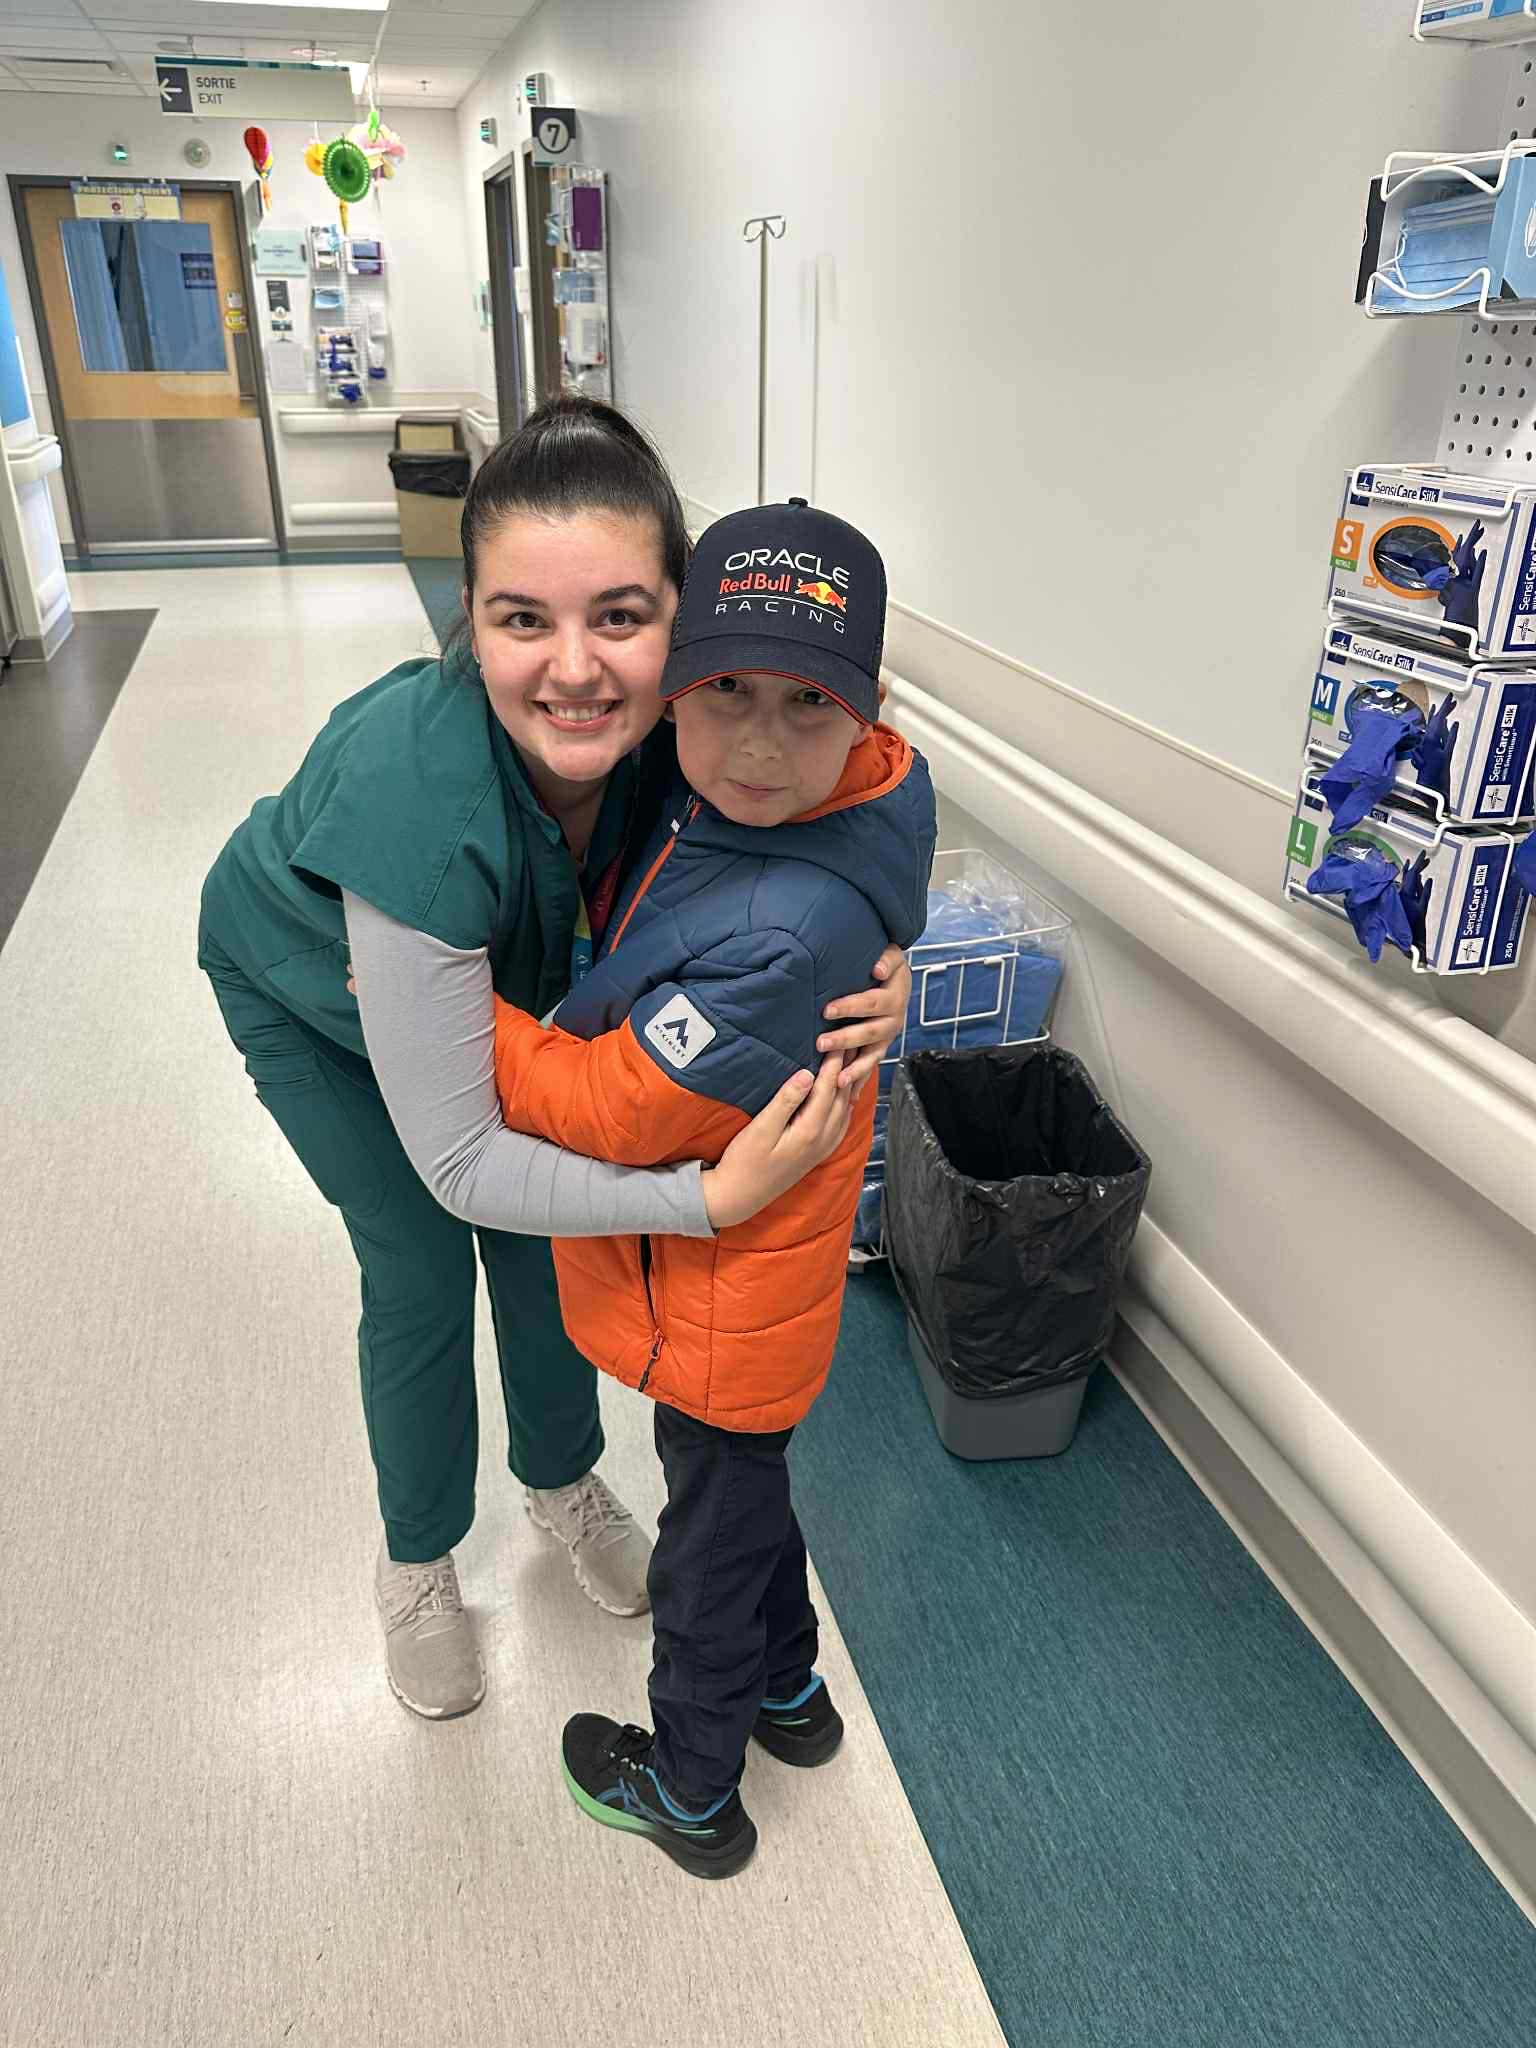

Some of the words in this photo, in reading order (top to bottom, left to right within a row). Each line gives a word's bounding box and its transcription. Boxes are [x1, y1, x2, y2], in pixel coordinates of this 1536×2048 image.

[196, 77, 236, 89] SORTIE
[199, 93, 223, 105] EXIT
[547, 123, 560, 147] 7
[1375, 481, 1418, 500] SensiCare
[1340, 525, 1355, 554] S
[725, 549, 850, 589] ORACLE
[719, 573, 753, 594] Red
[754, 573, 792, 593] Bull
[715, 600, 845, 634] RACING
[1352, 643, 1393, 665] SensiCare
[1314, 678, 1334, 709] M
[1489, 728, 1510, 782] SensiCare
[1504, 707, 1515, 725] Silk
[1295, 823, 1306, 851] L
[1463, 887, 1482, 936] SensiCare
[1475, 866, 1485, 884] Silk
